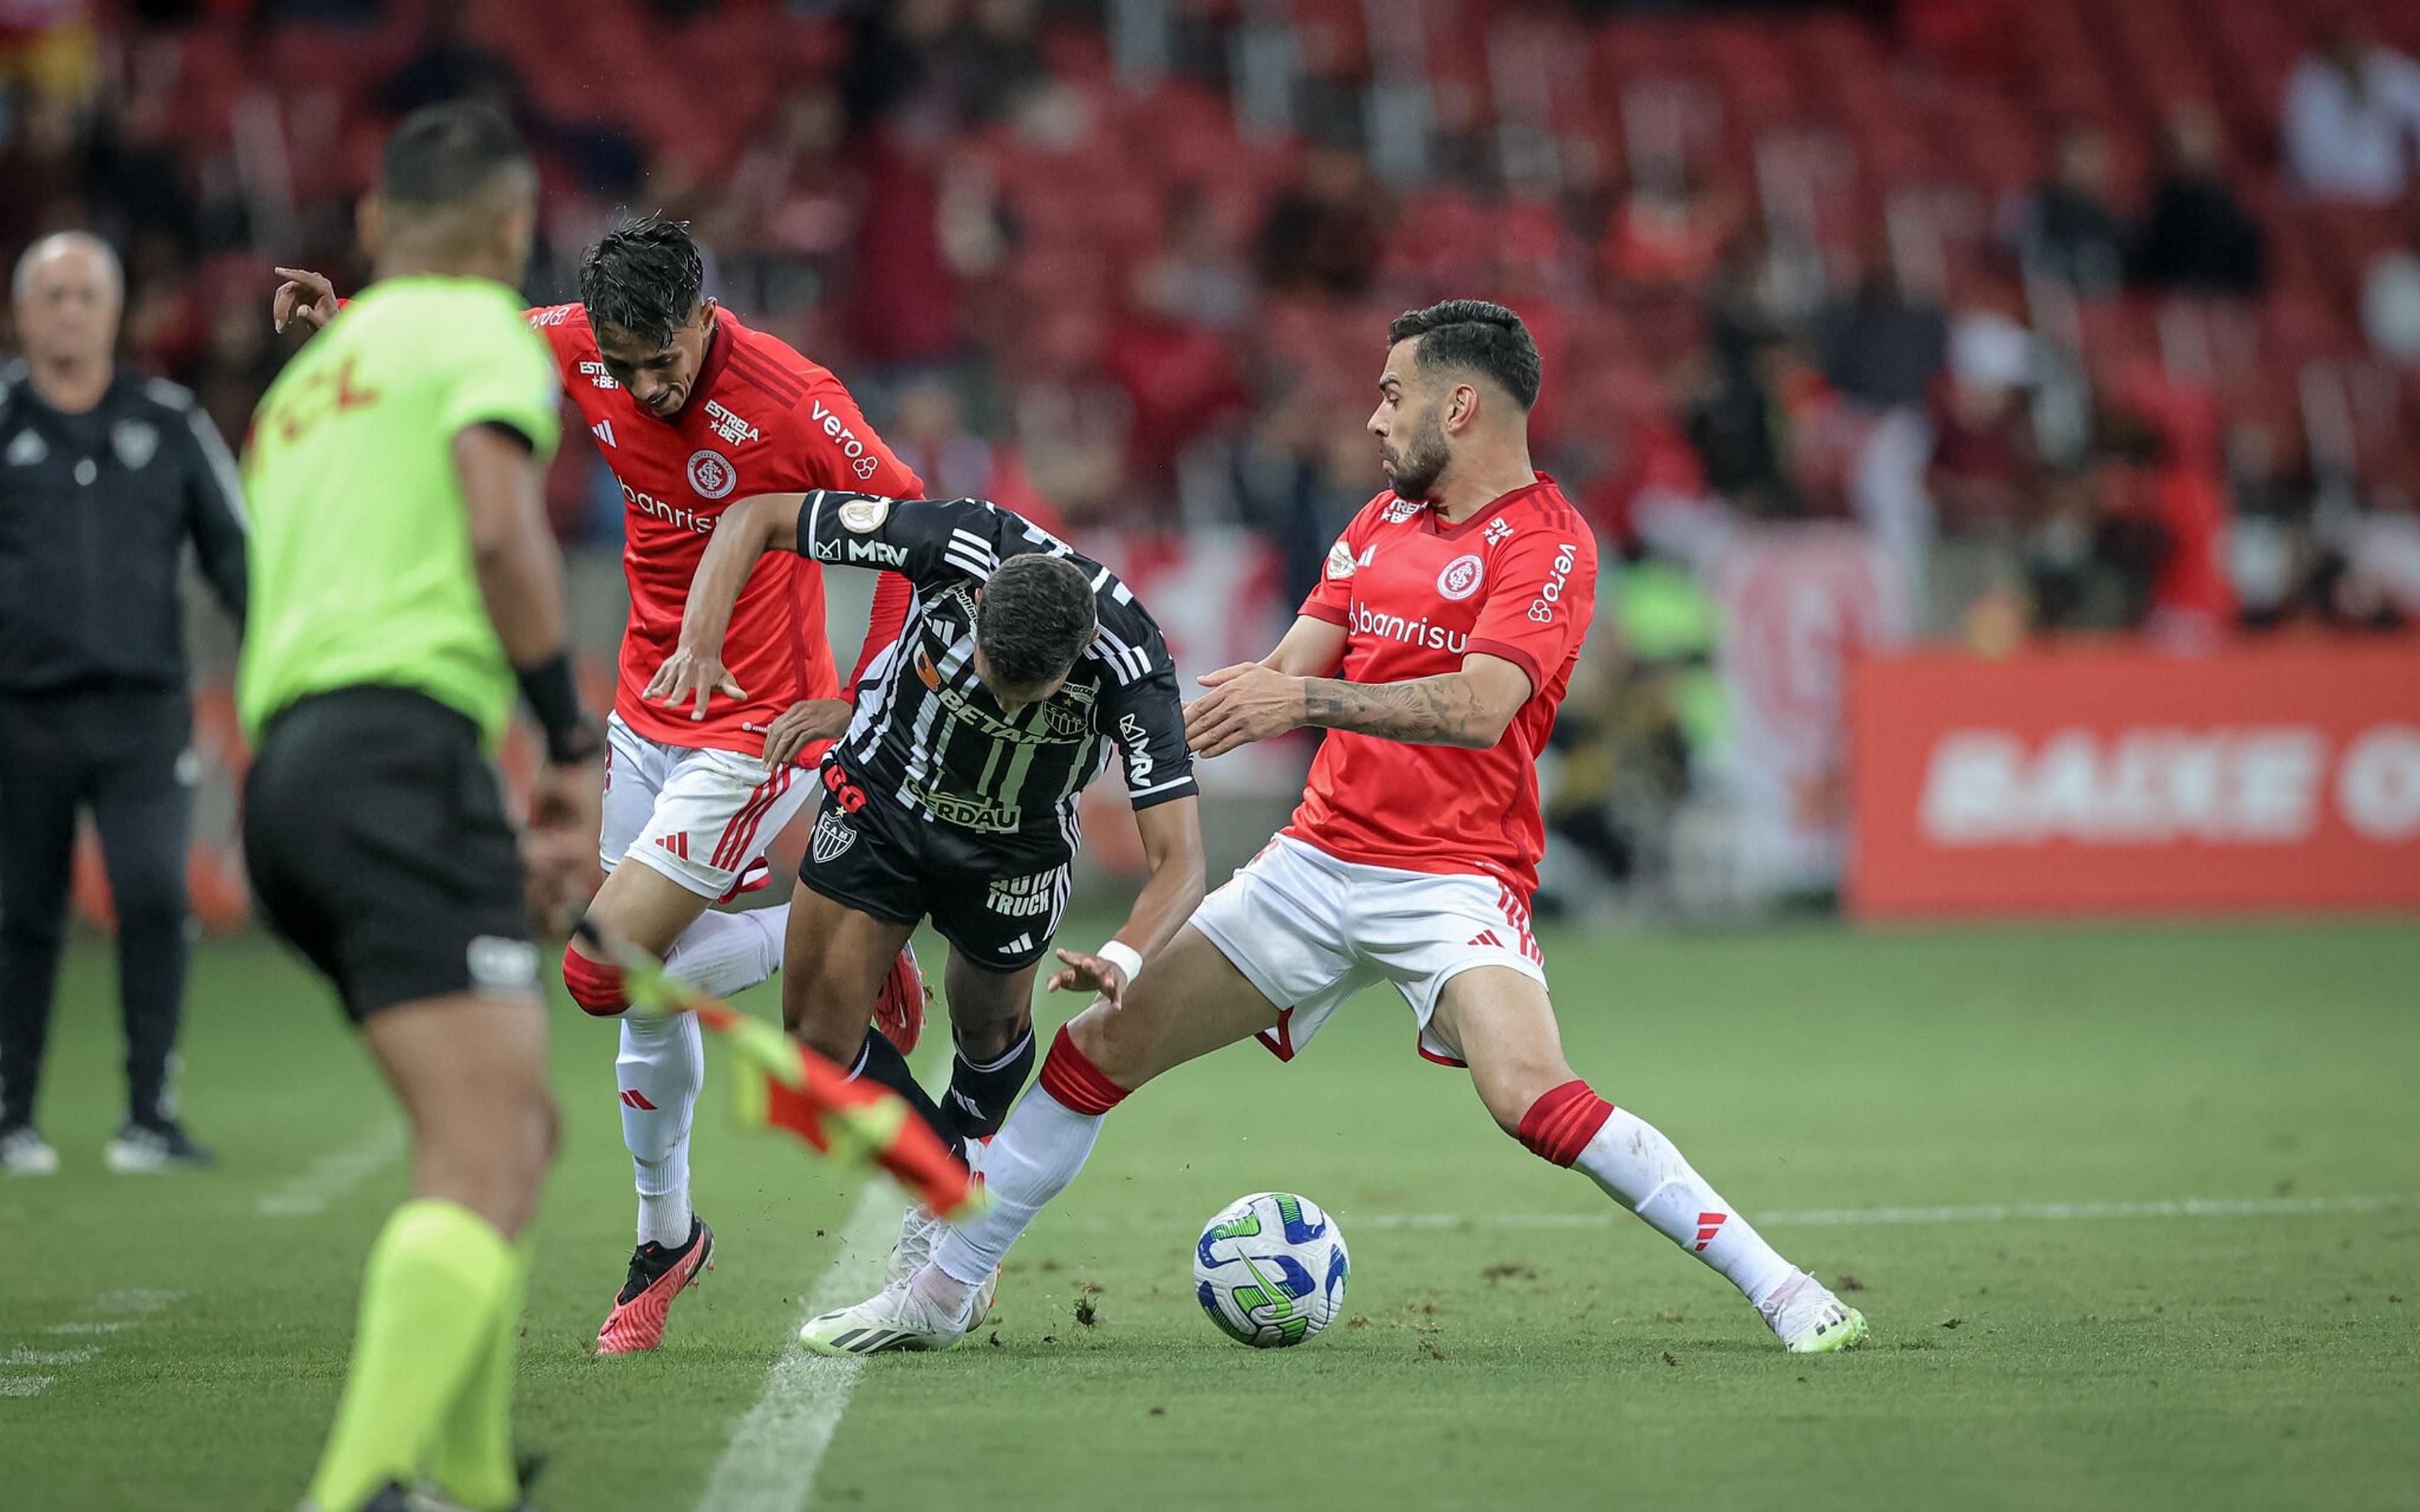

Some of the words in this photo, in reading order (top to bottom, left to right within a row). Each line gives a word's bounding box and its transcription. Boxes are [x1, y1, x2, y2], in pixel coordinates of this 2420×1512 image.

[704, 399, 760, 442] ESTRELA
[717, 423, 747, 447] BET
[811, 399, 863, 458] vero
[618, 474, 722, 534] banris
[848, 538, 909, 568] MRV
[1542, 544, 1577, 602] vero
[1129, 737, 1153, 788] MRV
[1920, 727, 2322, 845] BAIXE
[824, 821, 848, 840] CAM
[986, 886, 1050, 917] TRUCK
